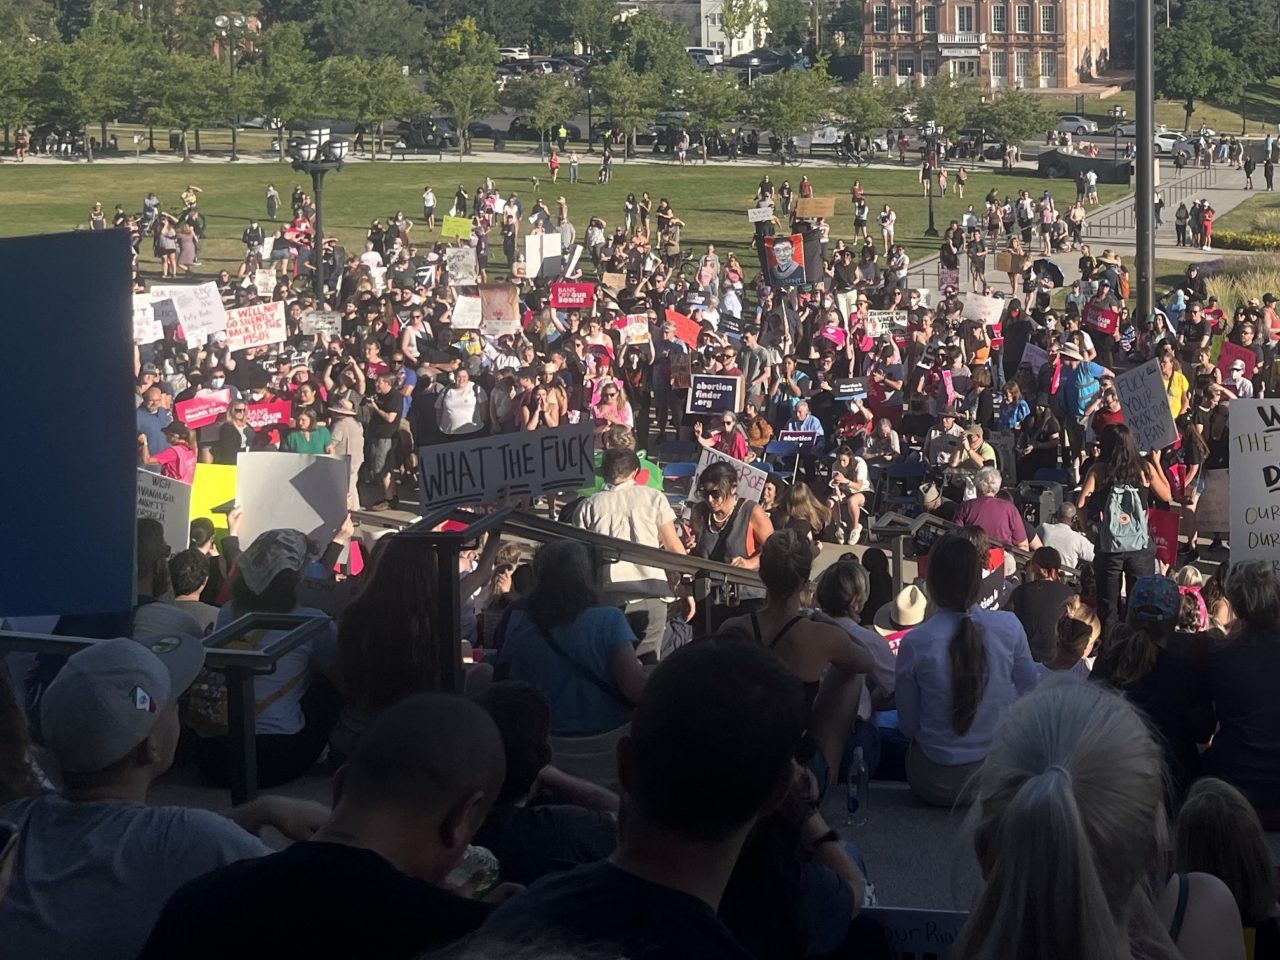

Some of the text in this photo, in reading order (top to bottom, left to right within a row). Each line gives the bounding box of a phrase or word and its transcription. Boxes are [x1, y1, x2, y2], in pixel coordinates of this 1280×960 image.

[227, 305, 280, 320] I WILL NOT
[226, 313, 275, 328] GO SILENTLY
[229, 319, 282, 337] BACK TO THE
[696, 381, 733, 391] abortion
[1118, 369, 1147, 398] FUCK
[695, 391, 722, 400] finder
[1123, 387, 1152, 415] YOUR
[694, 399, 712, 409] .org
[186, 409, 209, 420] Health
[262, 412, 282, 420] OUR
[1144, 422, 1166, 442] BAN
[1233, 432, 1273, 453] THE
[420, 433, 594, 502] WHAT THE FUCK
[152, 476, 171, 490] WISH
[138, 497, 165, 512] ARRETT
